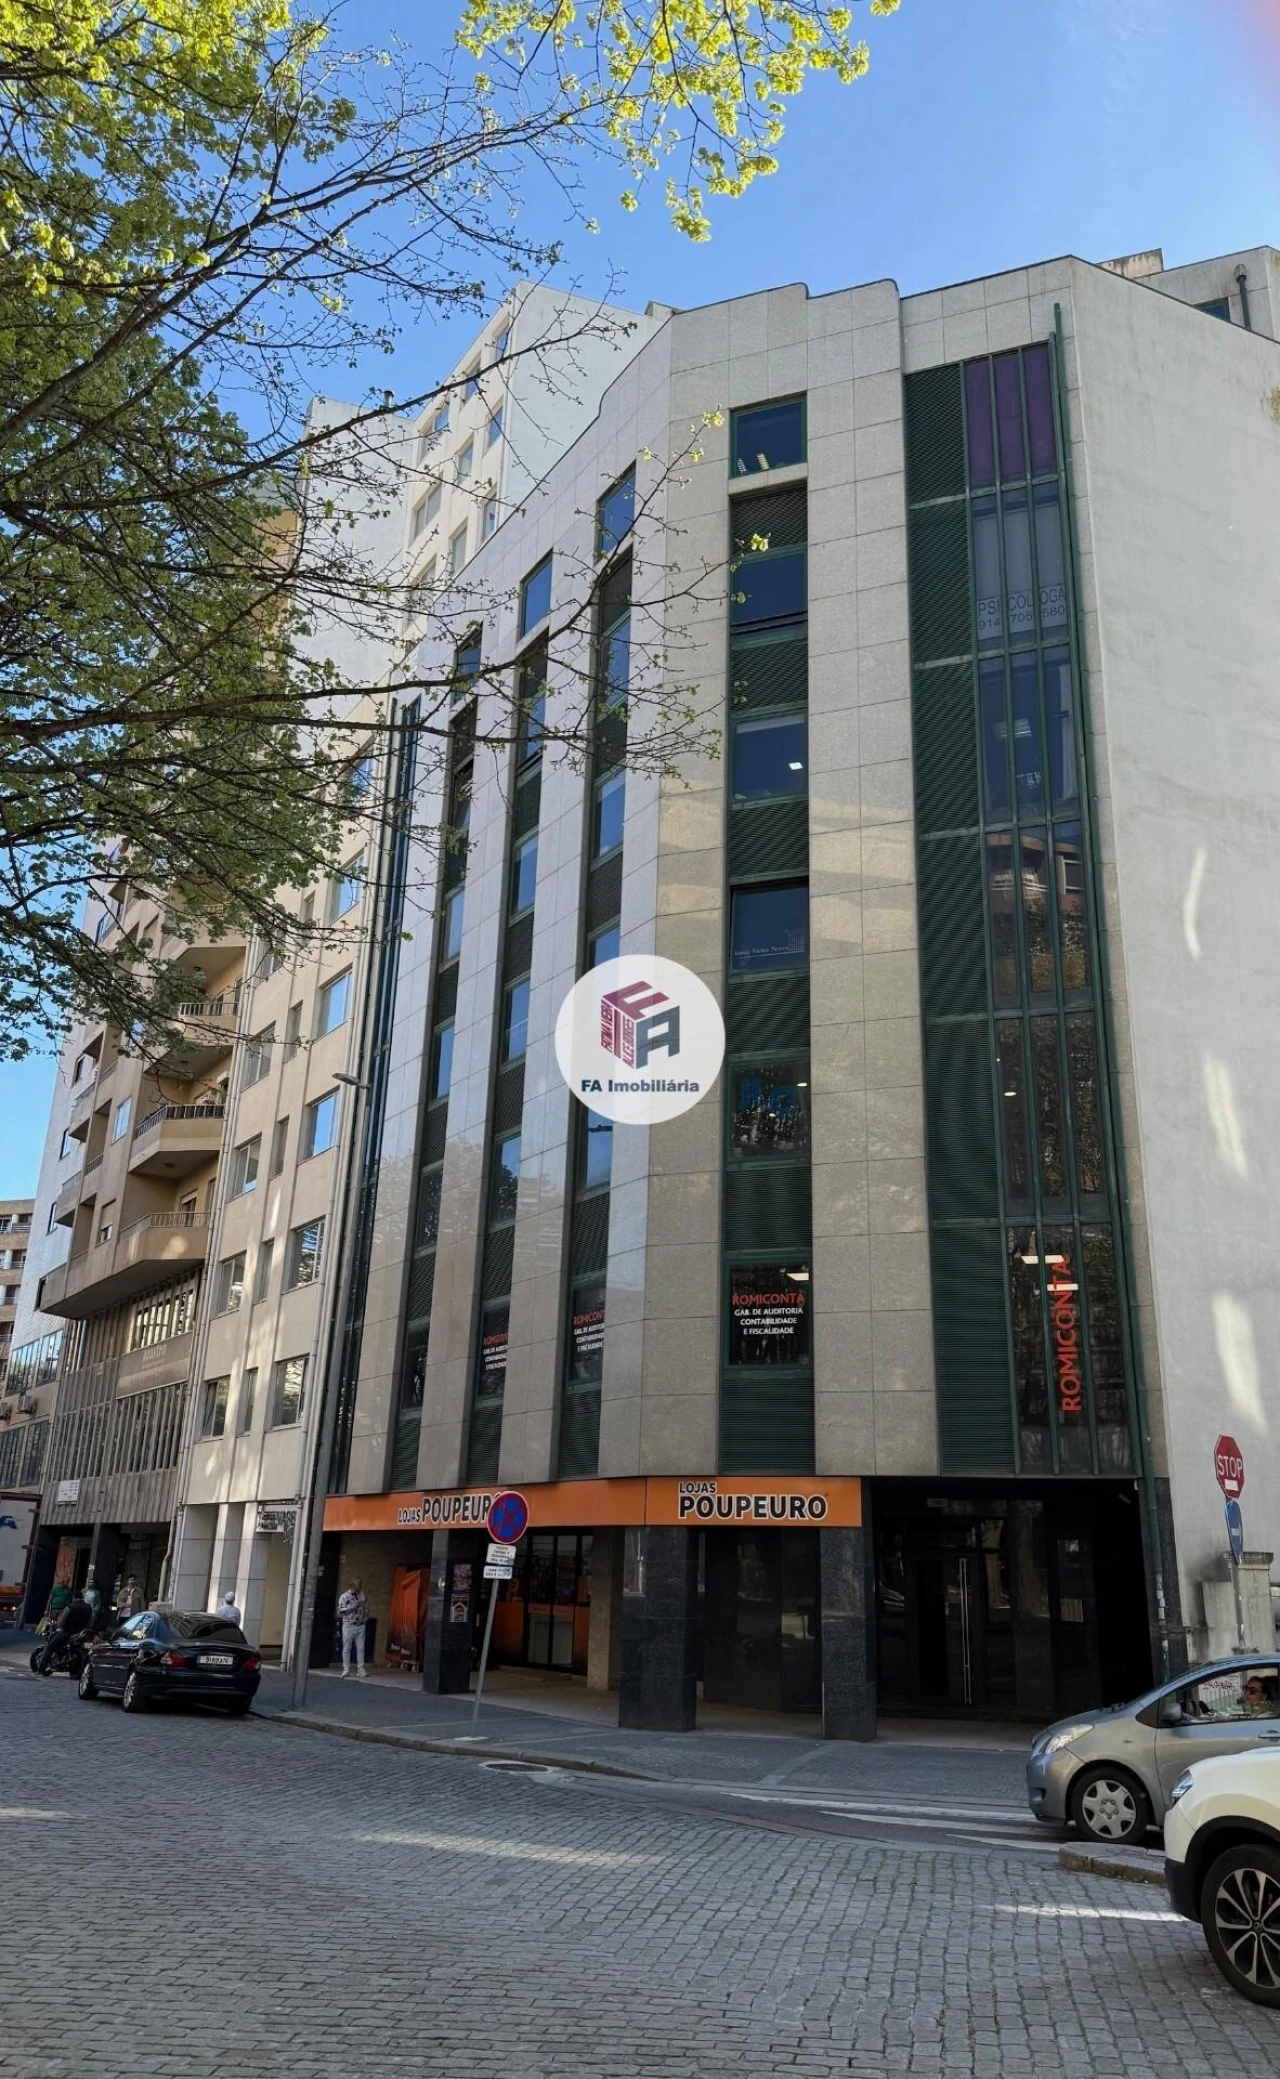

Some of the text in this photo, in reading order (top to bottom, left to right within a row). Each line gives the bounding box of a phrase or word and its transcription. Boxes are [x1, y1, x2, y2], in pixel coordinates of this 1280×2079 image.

[1009, 611, 1033, 624] 705
[1042, 605, 1065, 618] 580
[732, 1293, 805, 1305] ROMICONTA
[752, 1308, 762, 1316] DE
[763, 1307, 804, 1316] AUDITORIA
[740, 1317, 798, 1326] CONTABILIDADE
[749, 1327, 795, 1335] FISCALIDADE
[1051, 1254, 1082, 1412] ROMICONTA
[1217, 1454, 1243, 1479] STOP
[678, 1481, 717, 1495] LOJAS
[398, 1492, 498, 1525] LOJAS POUPEUR
[678, 1494, 828, 1520] POUPEURO
